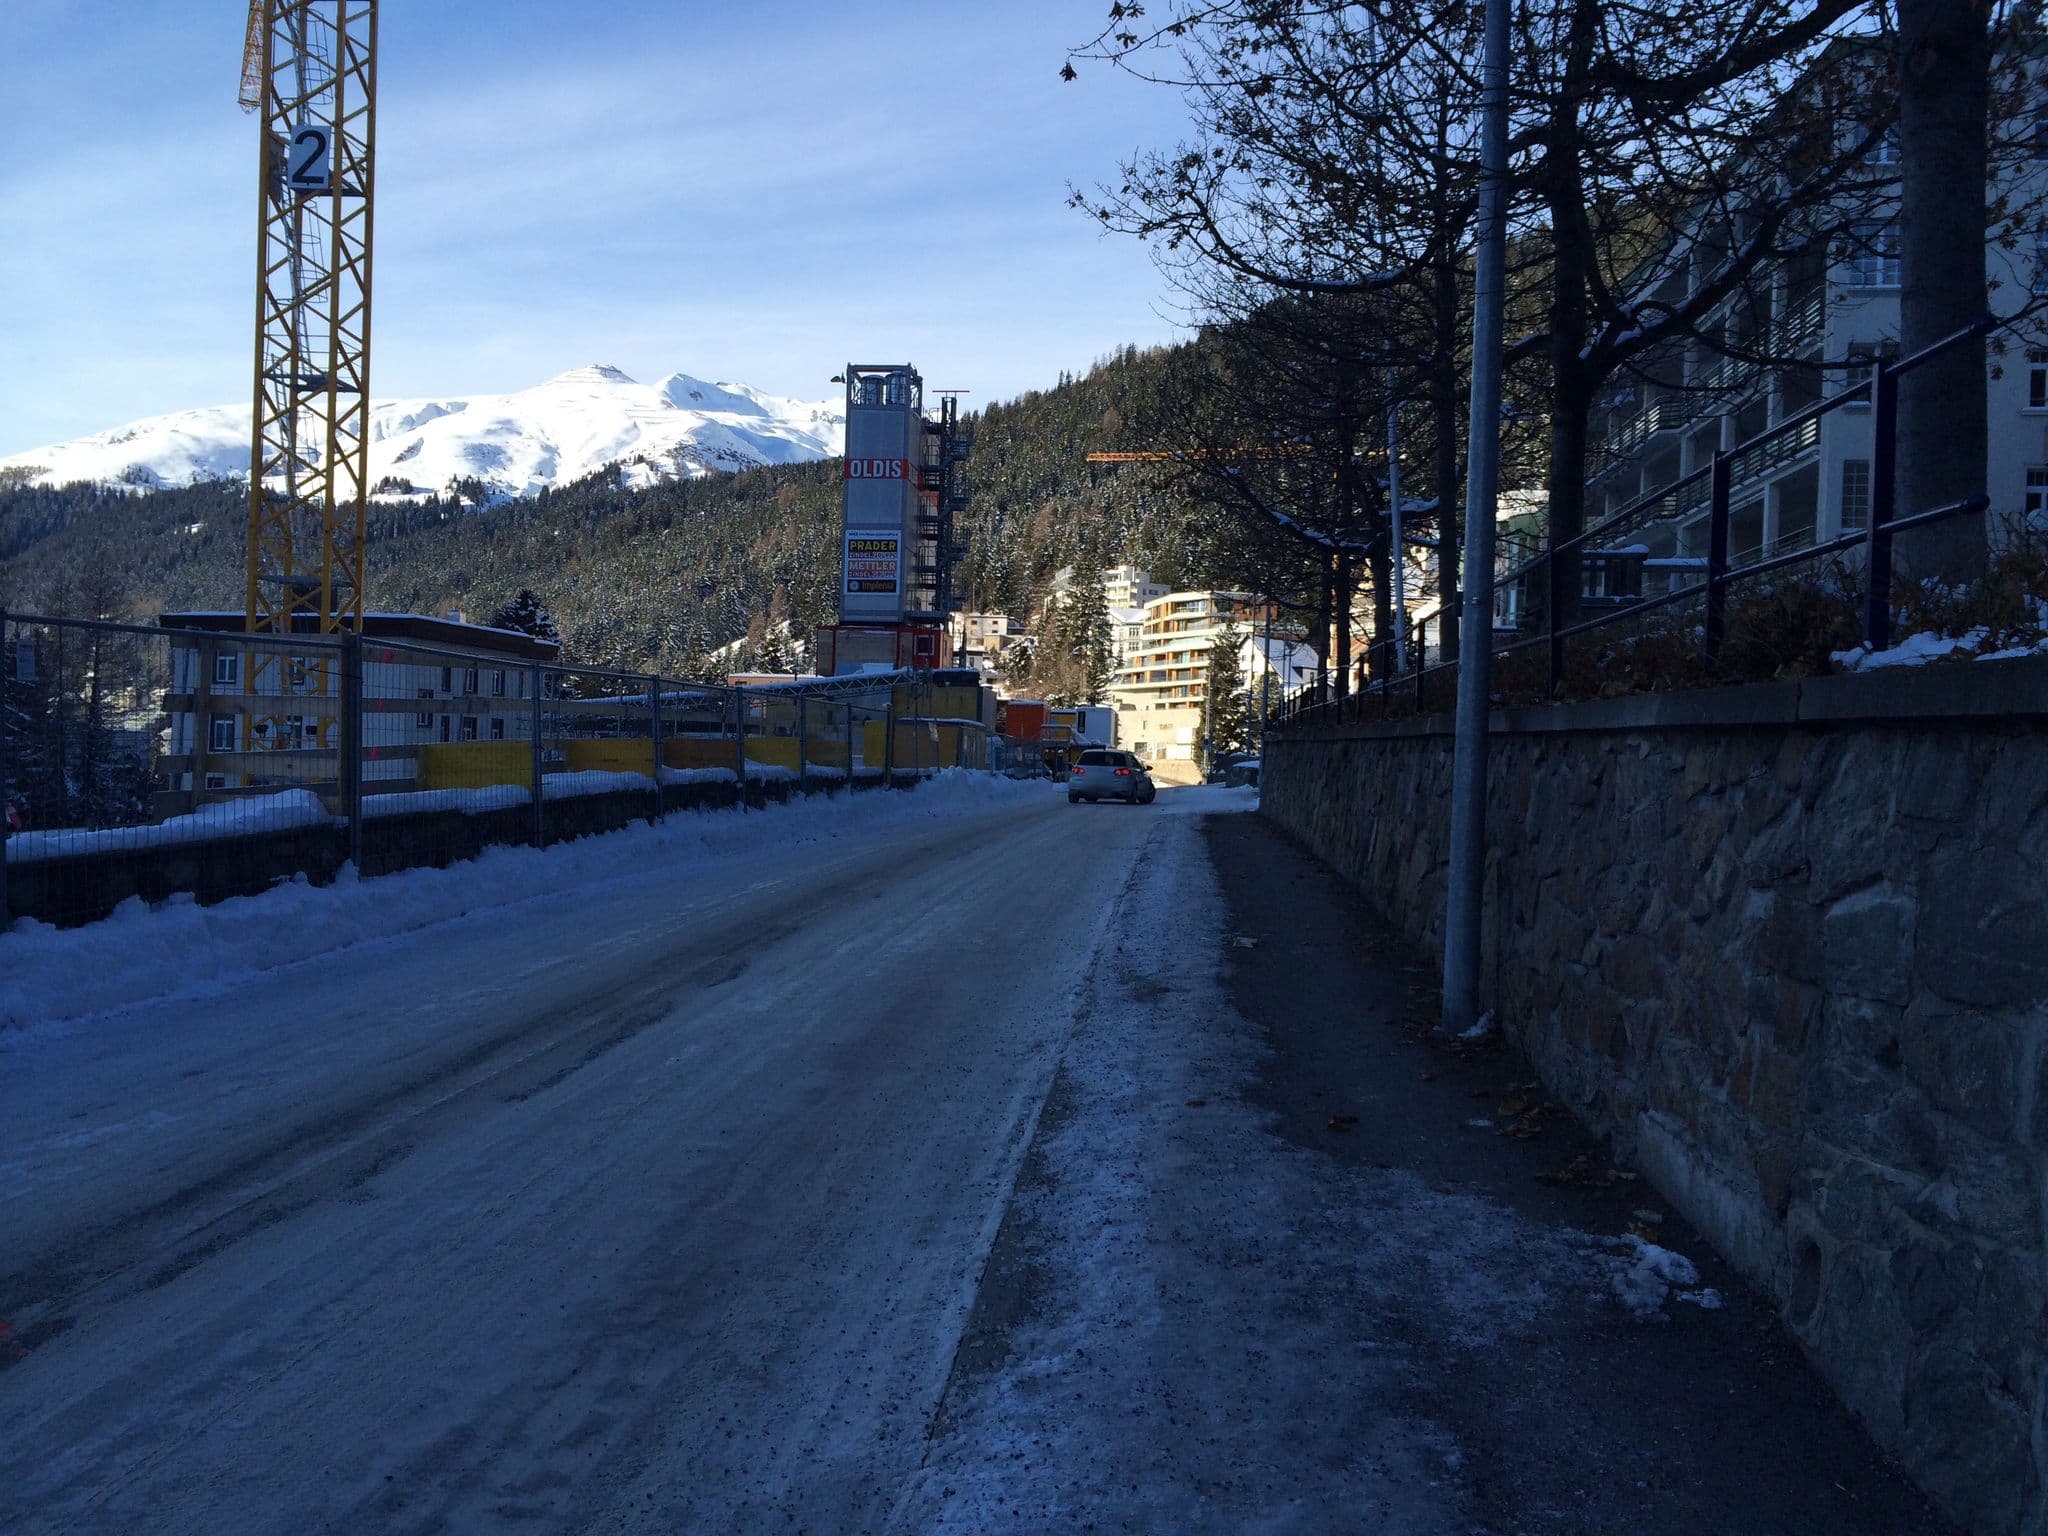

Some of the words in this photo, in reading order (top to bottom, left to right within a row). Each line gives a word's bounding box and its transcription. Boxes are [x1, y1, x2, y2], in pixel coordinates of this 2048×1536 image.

[292, 130, 327, 184] 2
[850, 459, 902, 478] OLDIS
[850, 540, 896, 551] PRADER
[849, 561, 896, 571] METTLER
